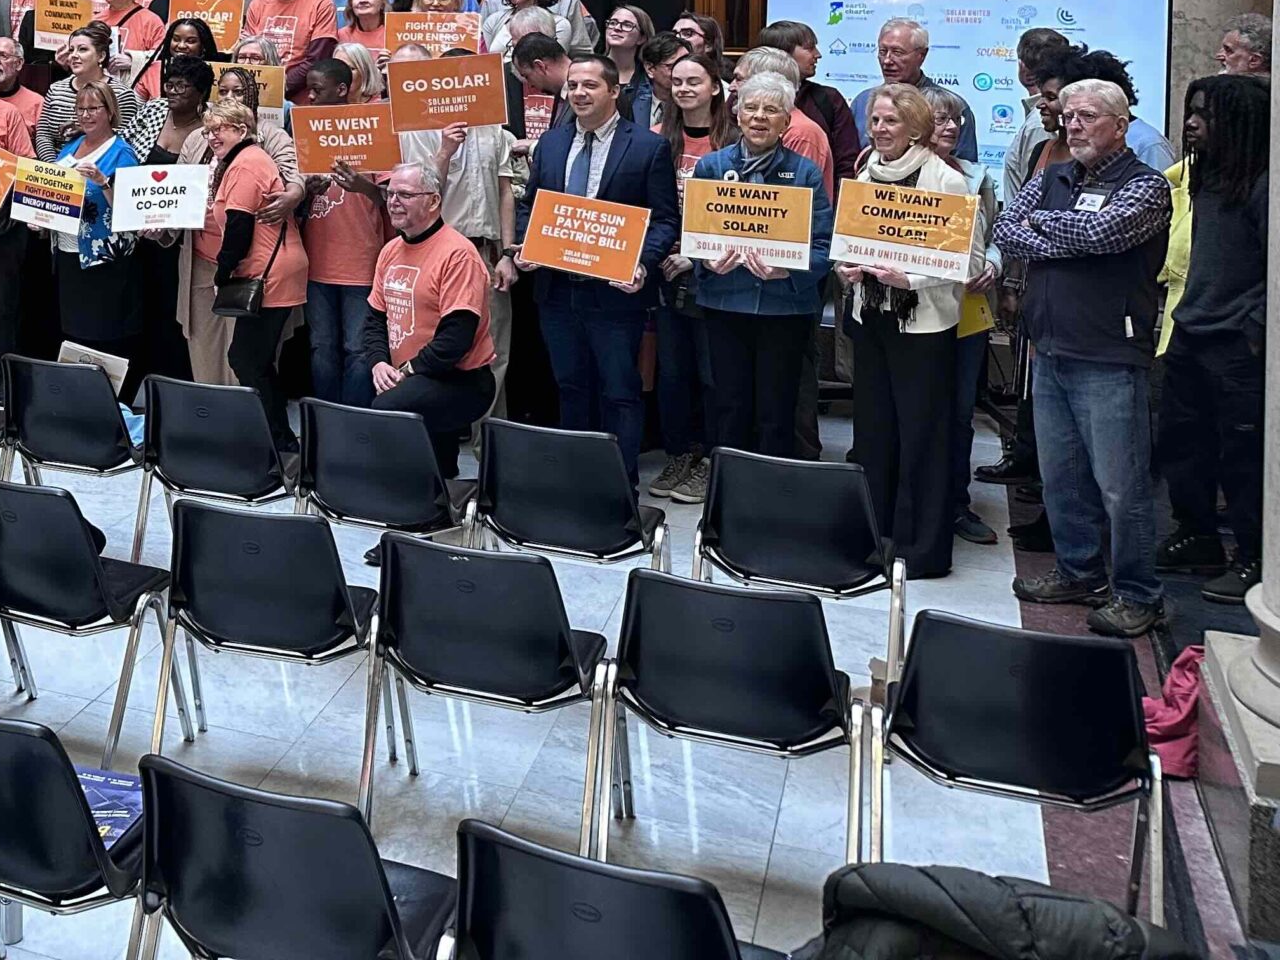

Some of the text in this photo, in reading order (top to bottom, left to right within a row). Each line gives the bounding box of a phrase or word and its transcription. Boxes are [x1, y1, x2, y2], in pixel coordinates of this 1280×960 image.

[49, 0, 78, 9] WE WANT
[44, 10, 82, 21] COMMUNITY
[177, 10, 233, 22] GO SOLAR!
[405, 21, 458, 32] FIGHT FOR
[396, 33, 467, 42] YOUR ENERGY
[402, 73, 491, 93] GO SOLAR!
[994, 77, 1014, 87] edp
[428, 95, 477, 106] SOLAR UNITED
[428, 104, 468, 114] NEIGHBORS
[309, 117, 380, 132] WE WENT
[319, 133, 374, 147] SOLAR!
[34, 164, 66, 178] GO SOLAR
[25, 173, 74, 191] JOIN TOGETHER
[25, 185, 71, 203] FIGHT FOR OUR
[132, 186, 187, 197] MY SOLAR
[716, 186, 780, 201] WE WANT
[874, 189, 942, 208] WE WANT
[22, 196, 71, 215] ENERGY RIGHTS
[136, 199, 179, 211] CO-OP!
[706, 202, 789, 219] COMMUNITY
[553, 204, 626, 227] LET THE SUN
[861, 205, 950, 227] COMMUNITY
[556, 216, 618, 237] PAY YOUR
[722, 220, 769, 234] SOLAR!
[878, 225, 928, 242] SOLAR!
[541, 225, 627, 251] ELECTRIC BILL!
[696, 240, 803, 261] SOLAR UNITED NEIGHBORS
[847, 244, 961, 271] SOLAR UNITED NEIGHBORS
